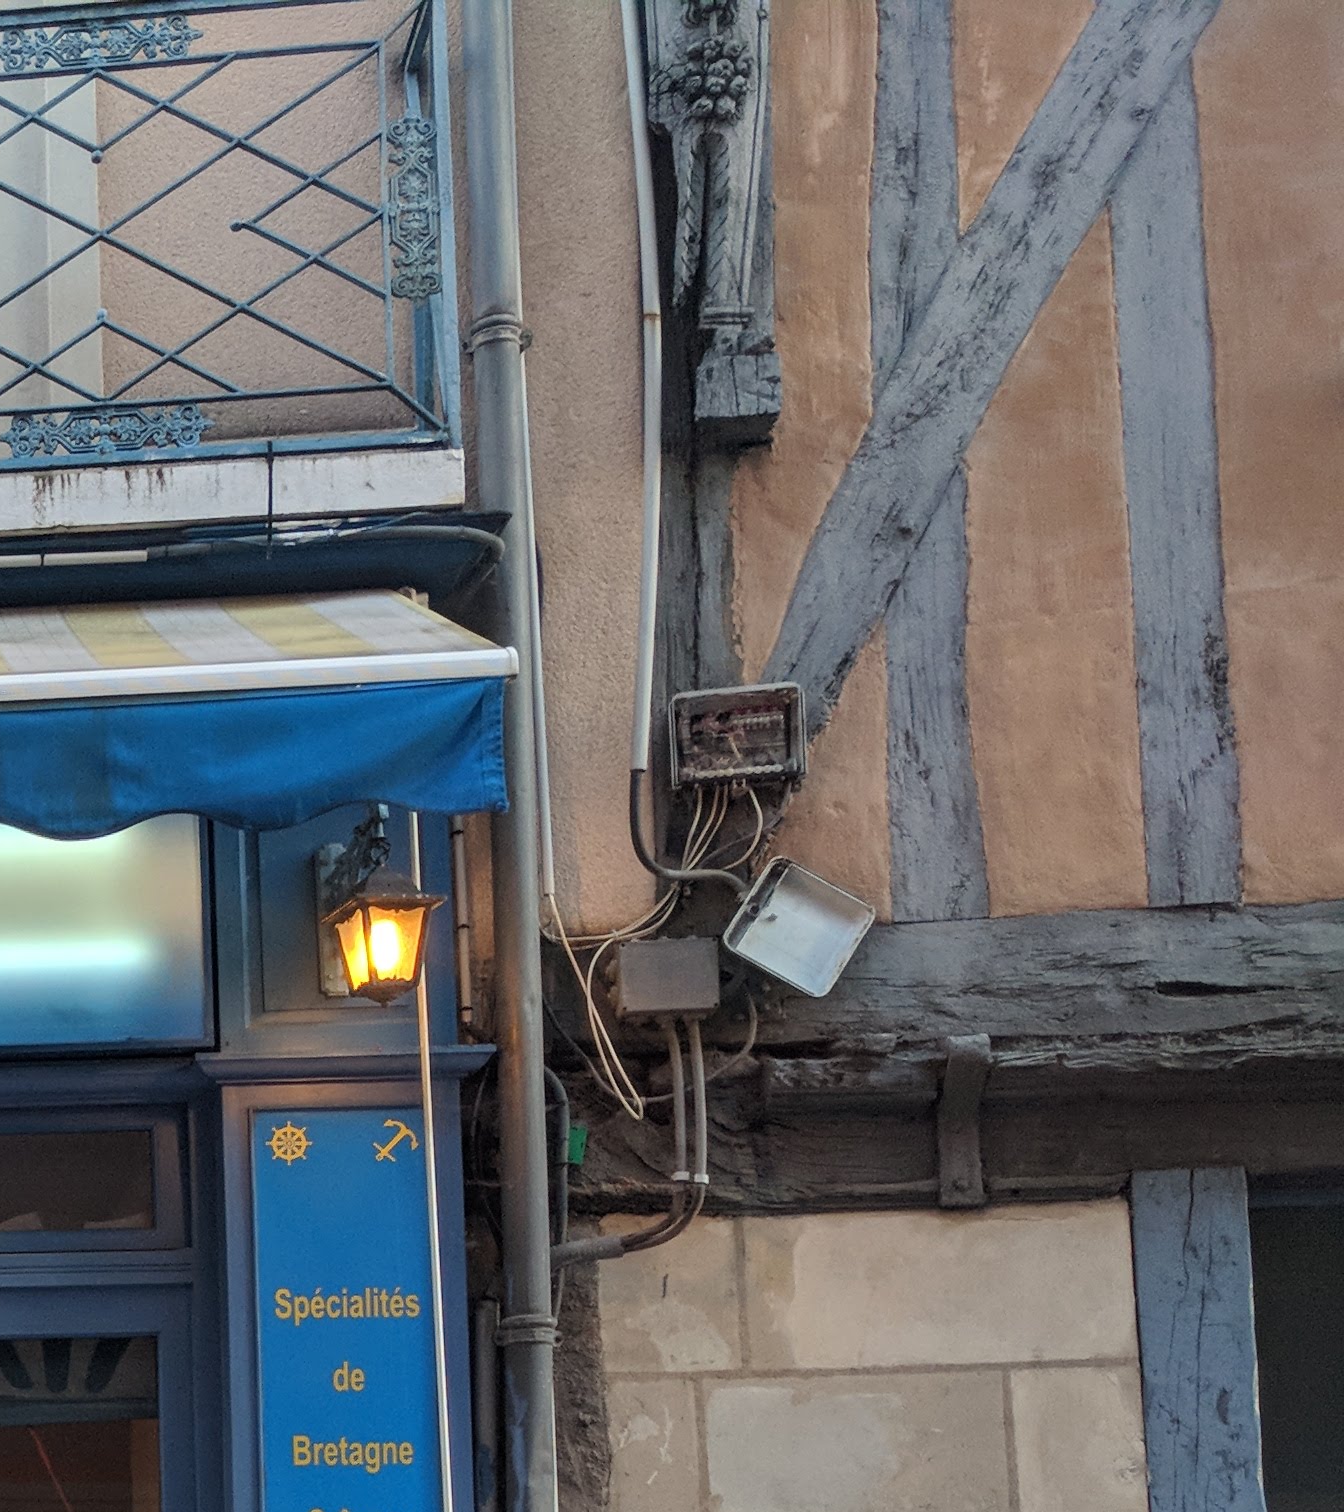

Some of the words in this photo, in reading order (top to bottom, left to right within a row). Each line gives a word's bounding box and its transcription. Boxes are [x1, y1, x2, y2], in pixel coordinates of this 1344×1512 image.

[274, 1286, 421, 1326] Spécialités
[332, 1361, 365, 1392] de
[291, 1435, 413, 1473] Bretagne
